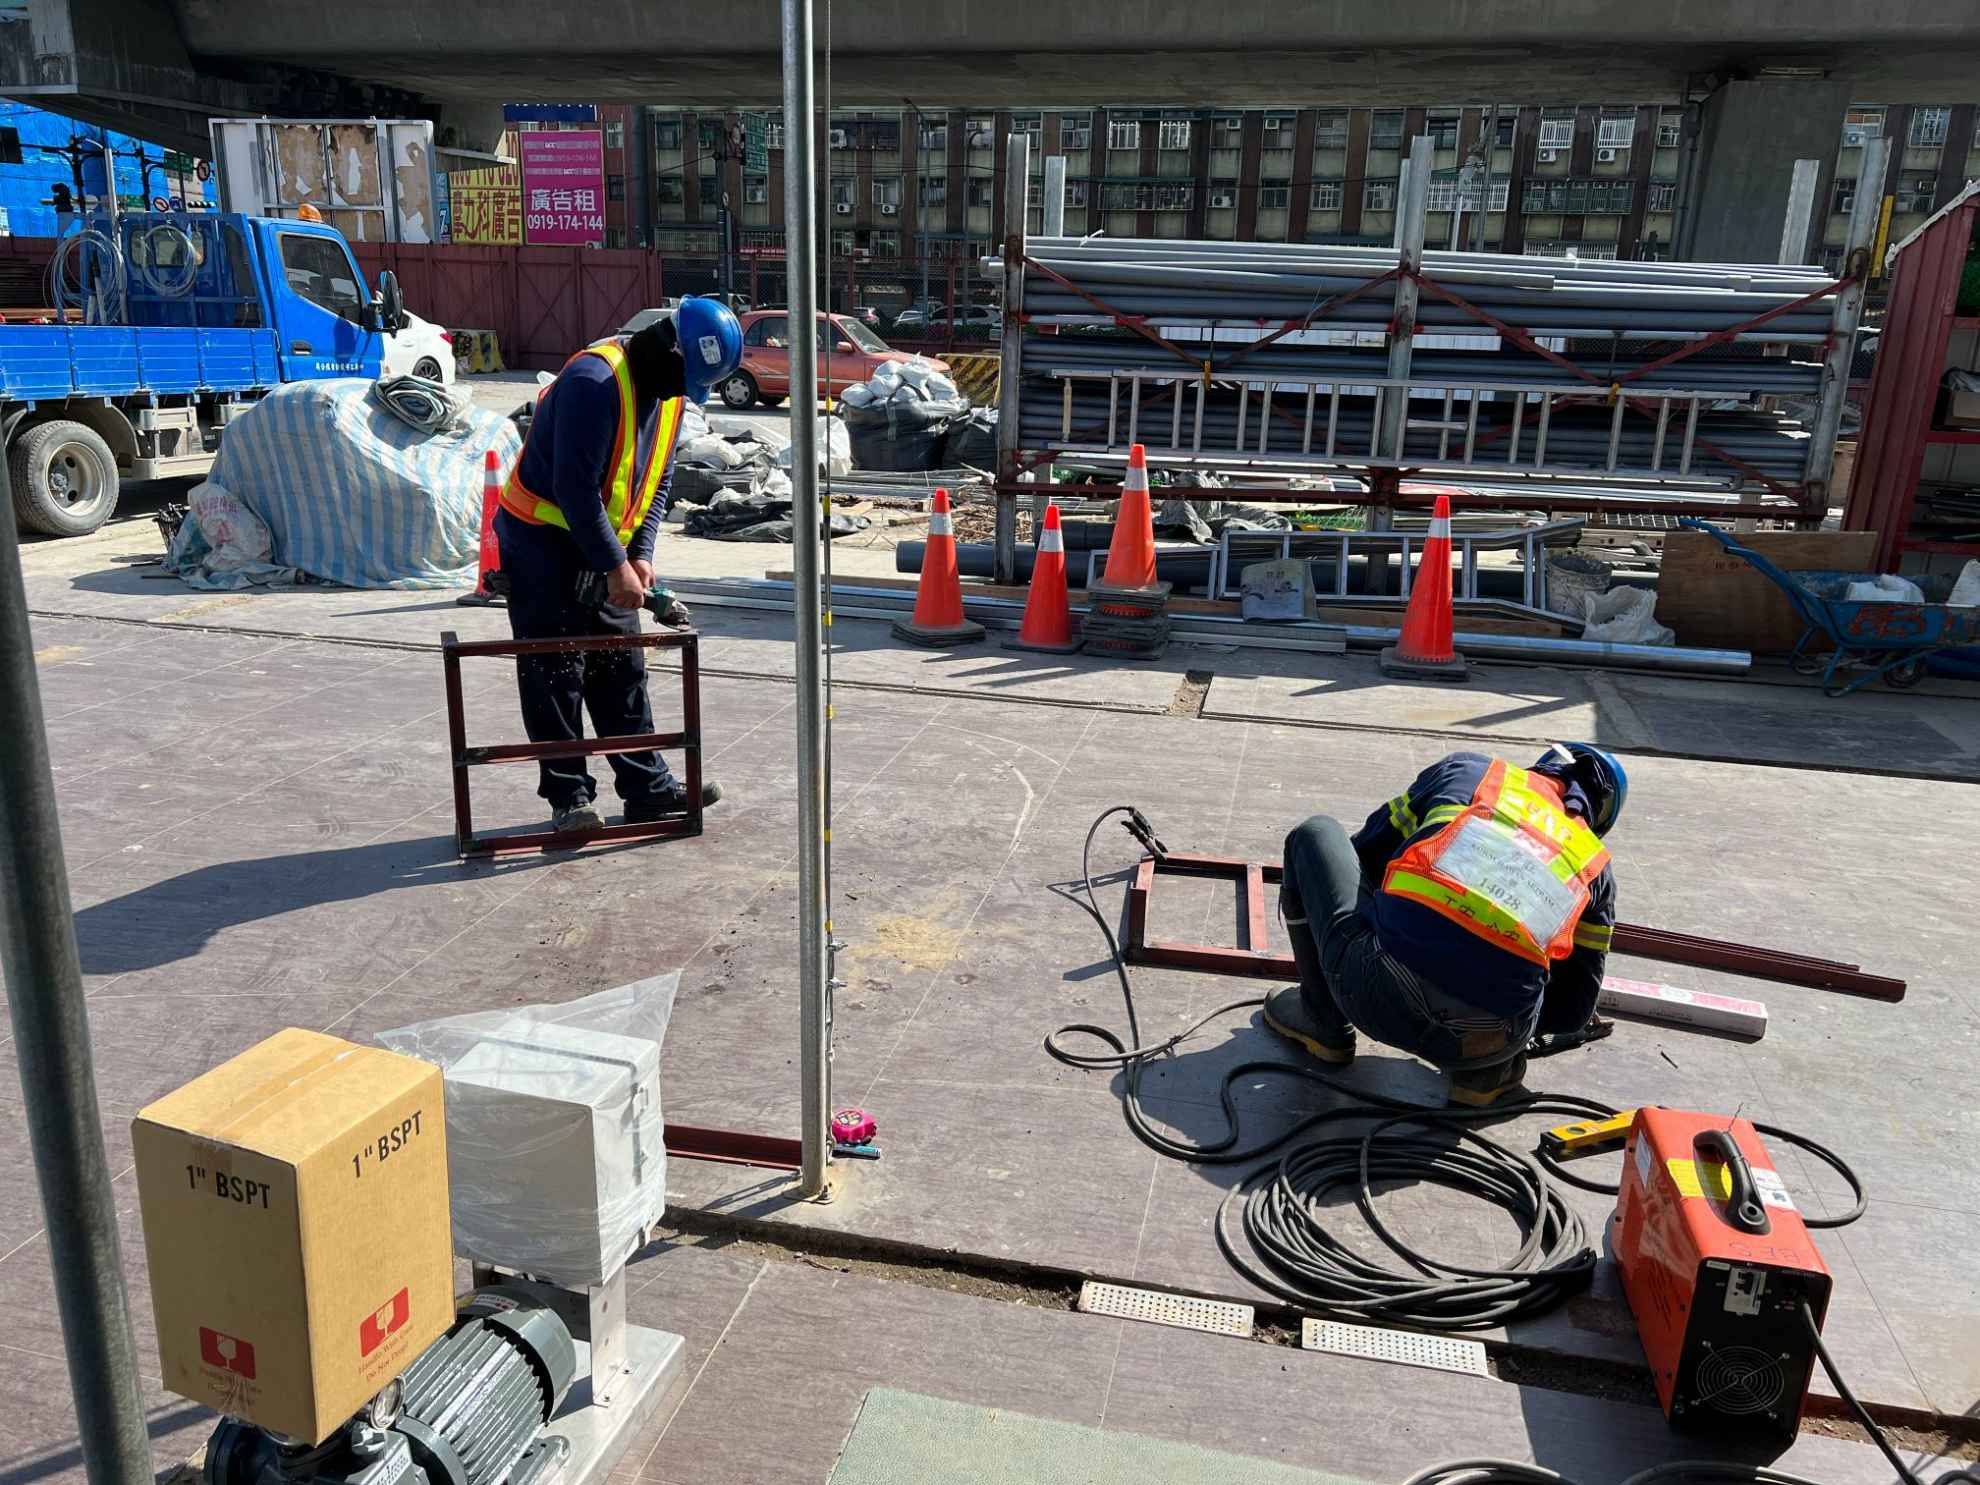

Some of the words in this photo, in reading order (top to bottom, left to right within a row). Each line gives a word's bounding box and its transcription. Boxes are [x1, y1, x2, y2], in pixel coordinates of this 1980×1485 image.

[531, 188, 596, 212] 廣告租
[527, 214, 603, 230] 0919-174-144
[1480, 878, 1521, 910] 14028
[352, 1145, 373, 1178] 1"
[378, 1110, 422, 1162] BSPT
[186, 1164, 206, 1190] 1"
[215, 1171, 271, 1209] BSPT
